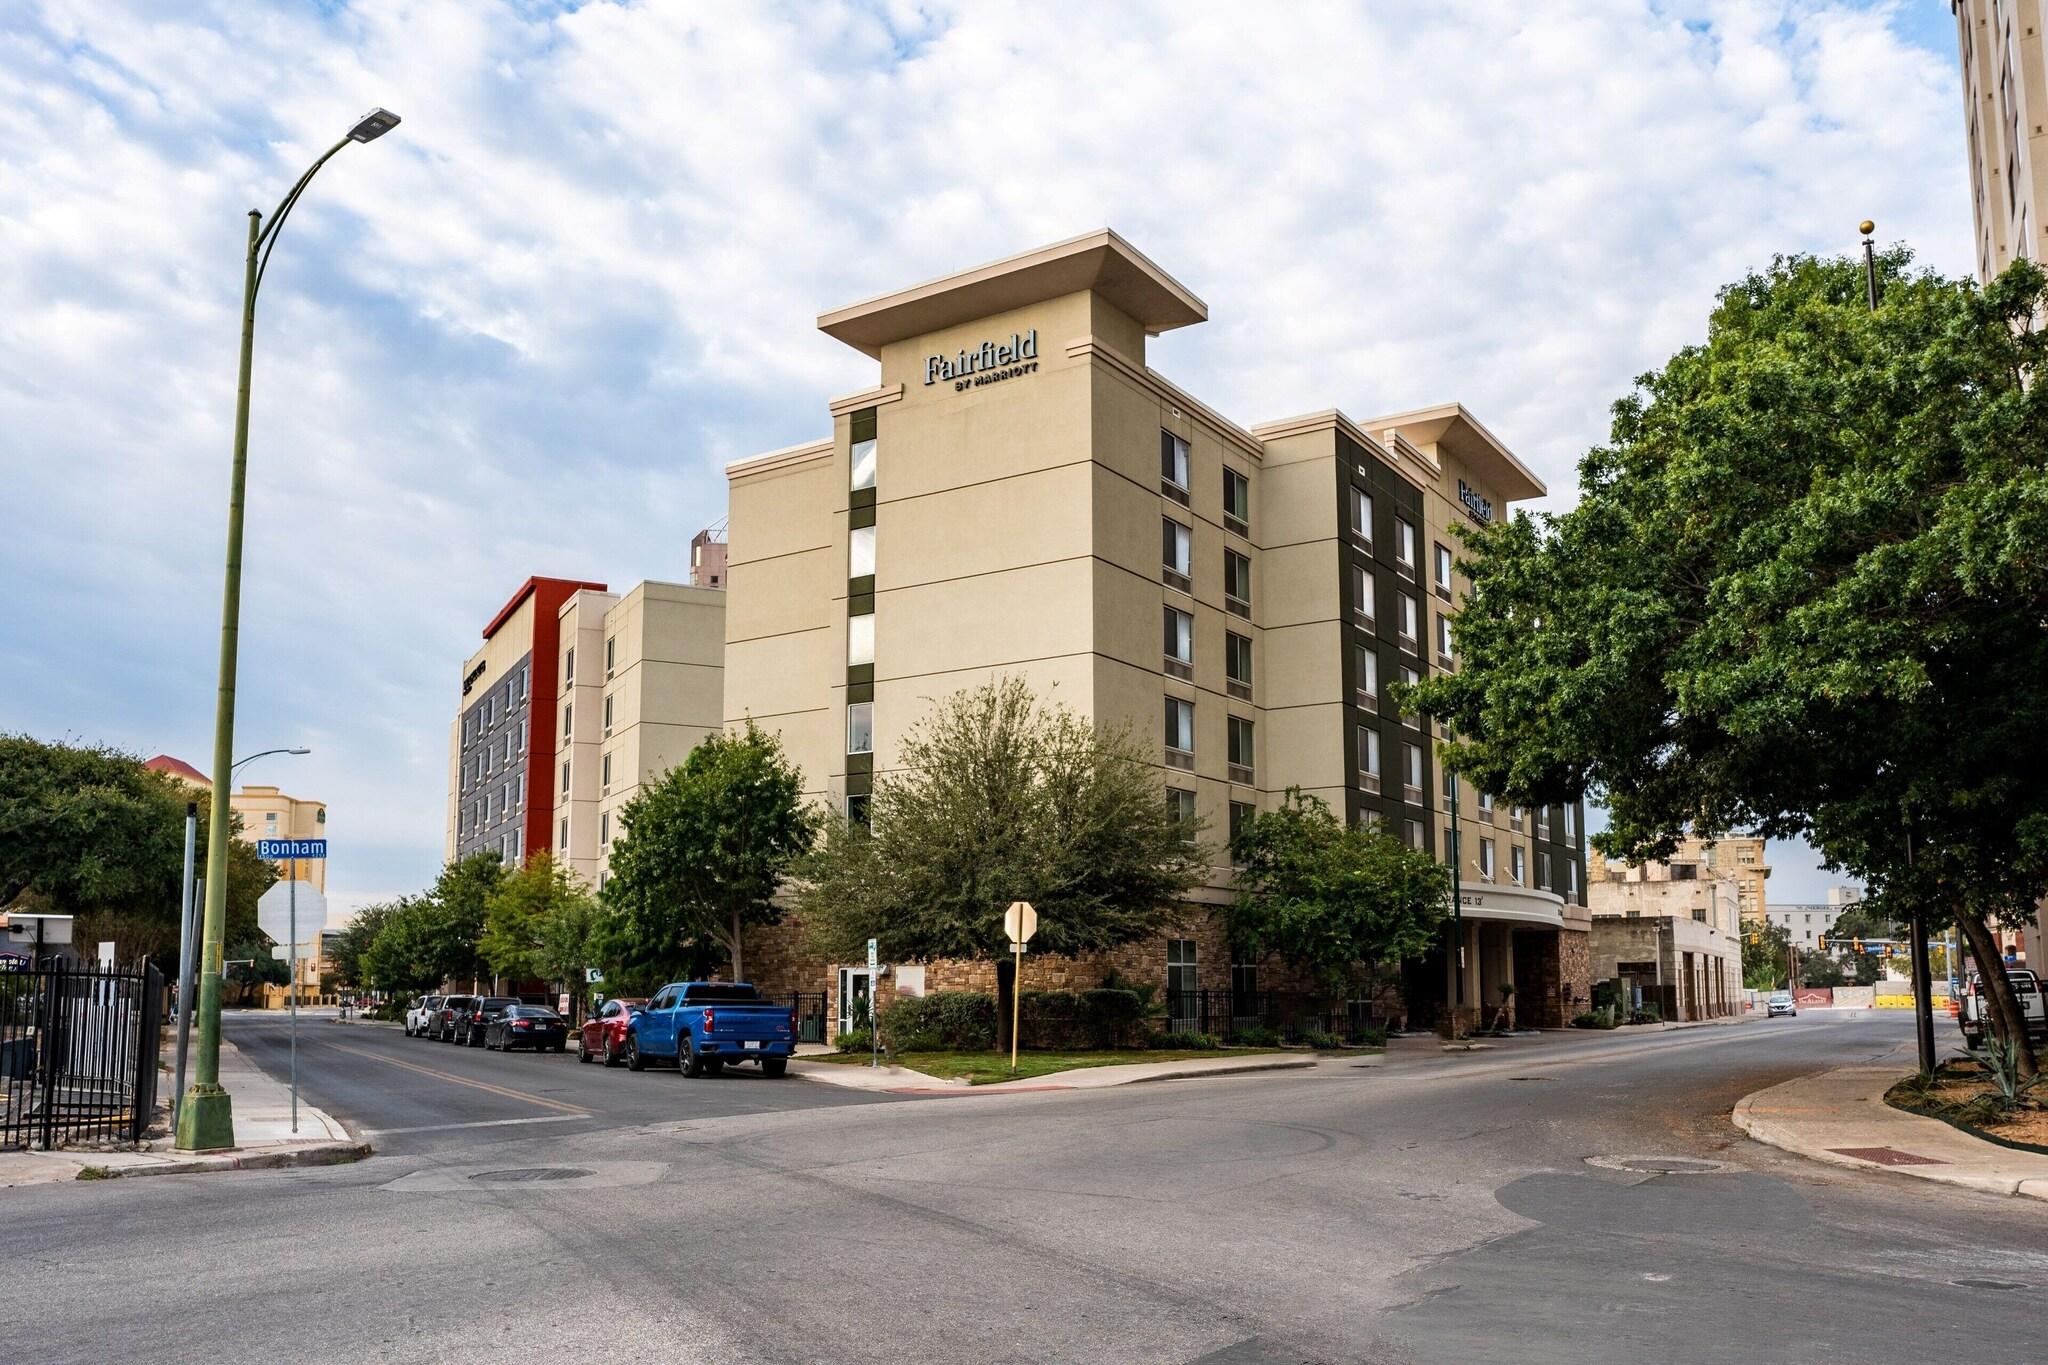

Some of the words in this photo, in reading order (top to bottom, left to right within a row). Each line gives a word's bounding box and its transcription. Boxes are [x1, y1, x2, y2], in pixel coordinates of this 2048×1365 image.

[924, 329, 1037, 386] Fairfield
[955, 379, 971, 391] BY
[975, 362, 1039, 387] MARRIOTT
[260, 841, 324, 855] Bonham
